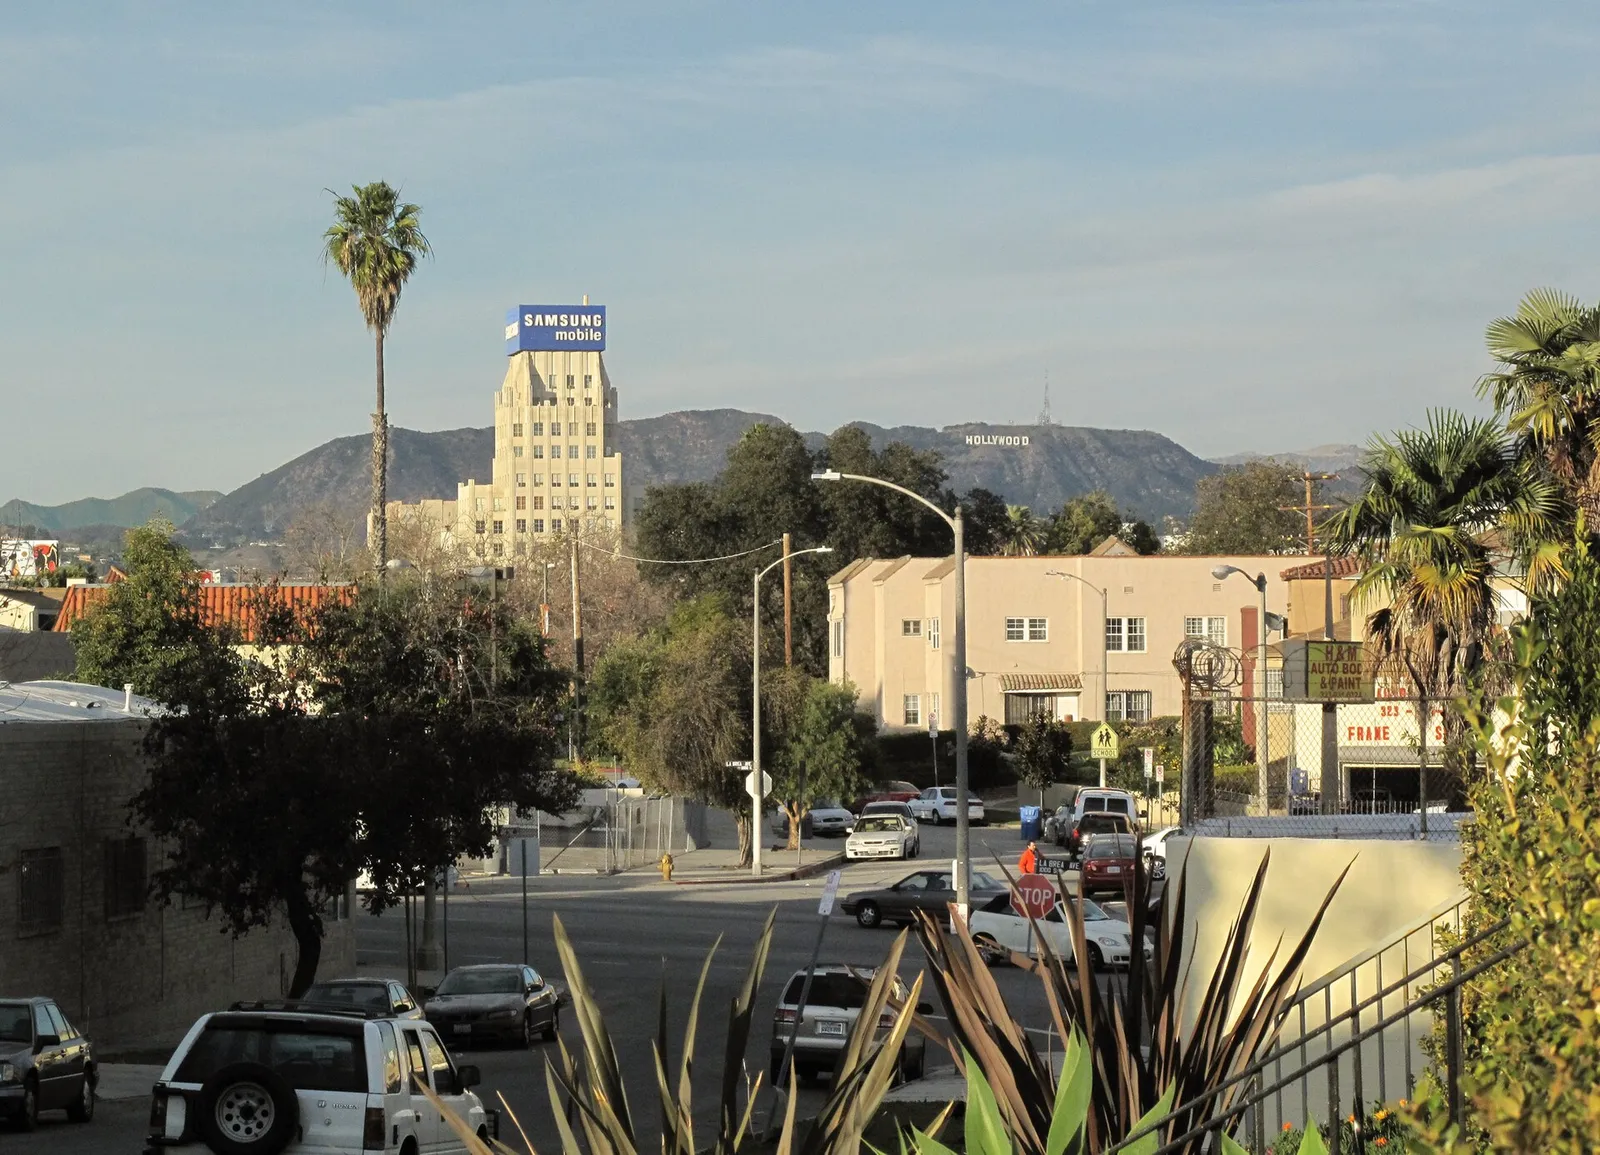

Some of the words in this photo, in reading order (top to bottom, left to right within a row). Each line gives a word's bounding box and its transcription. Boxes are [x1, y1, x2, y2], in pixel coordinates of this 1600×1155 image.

[524, 314, 602, 327] SAMSUNG
[555, 328, 602, 341] mobile
[965, 435, 1029, 445] HOLLYWOOD
[1311, 662, 1339, 674] AUTO
[1342, 663, 1363, 674] BOD
[1331, 677, 1362, 690] PAINT
[1347, 726, 1390, 741] FRAME
[1039, 859, 1047, 867] LA
[1048, 860, 1065, 869] BREA
[1069, 862, 1080, 870] AVE
